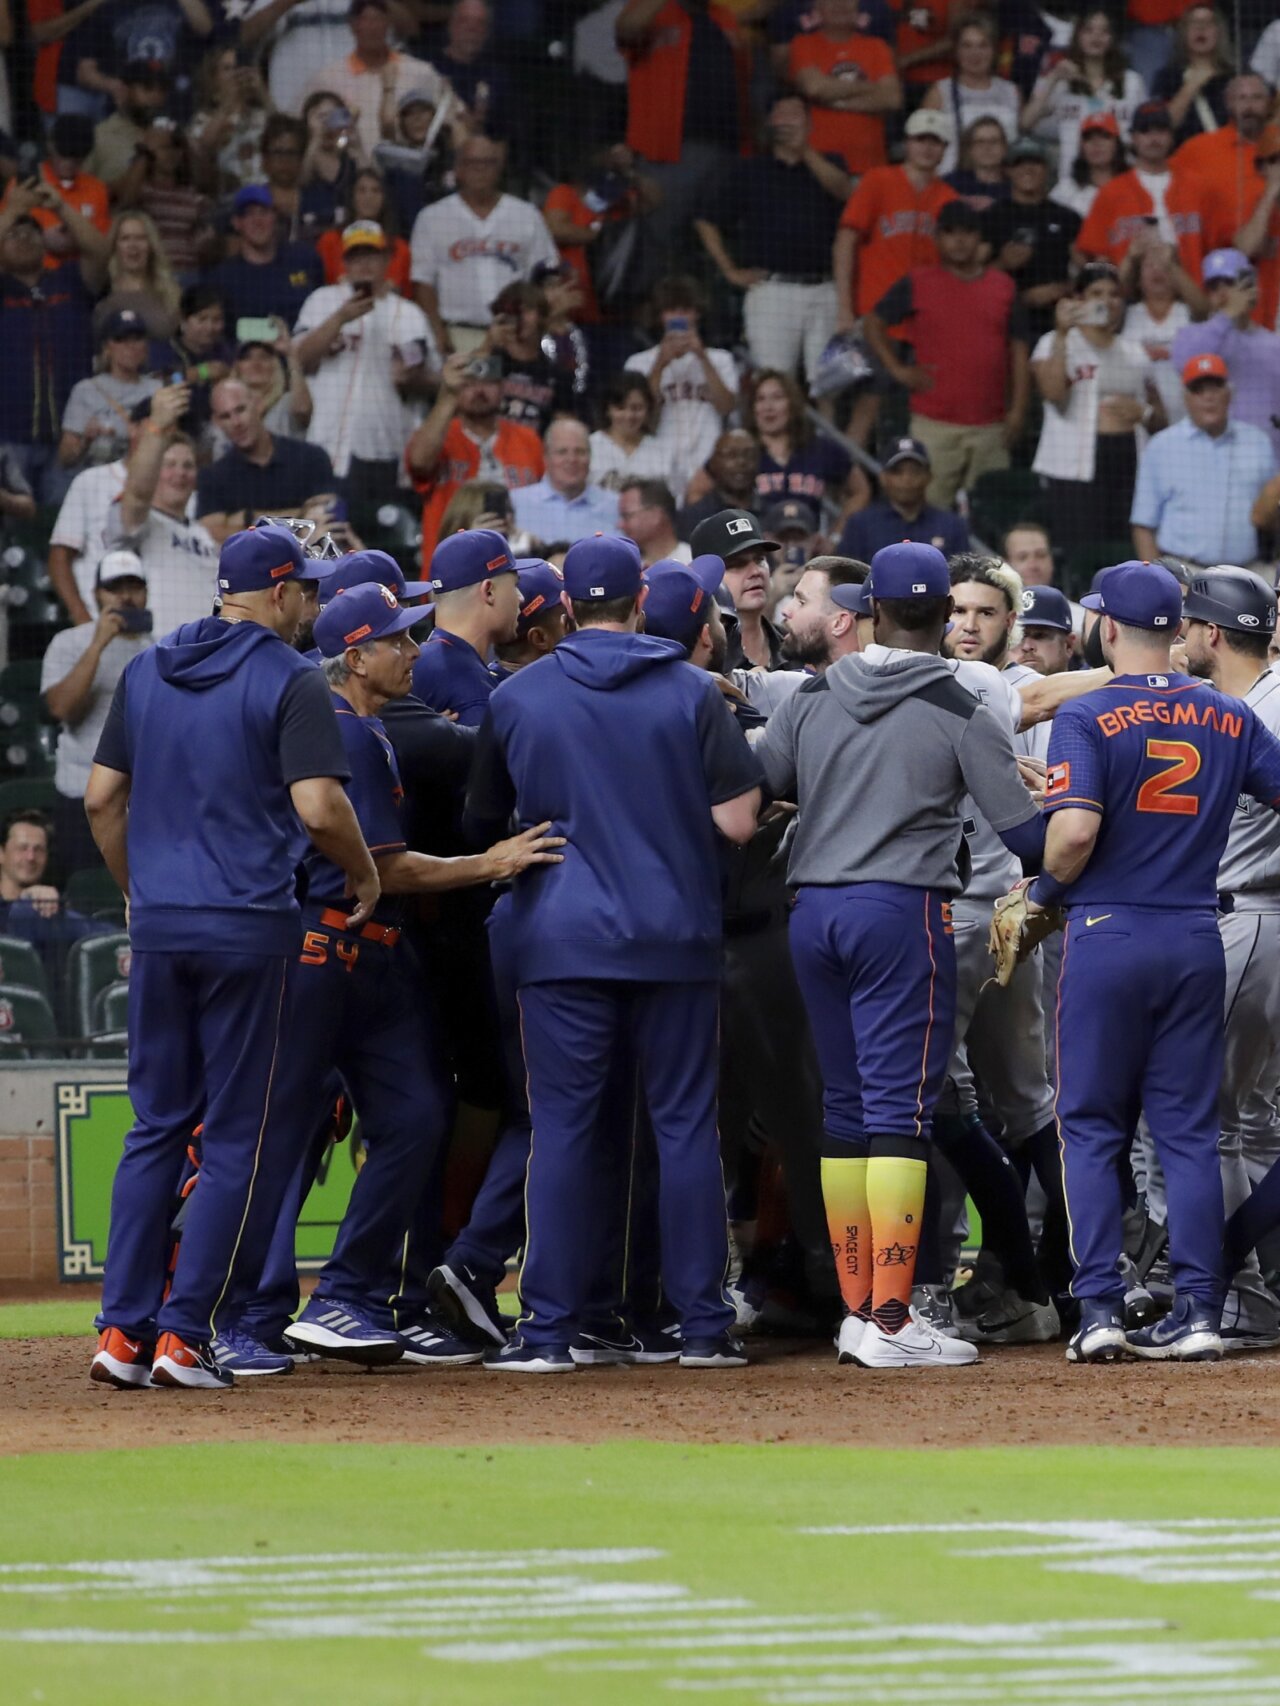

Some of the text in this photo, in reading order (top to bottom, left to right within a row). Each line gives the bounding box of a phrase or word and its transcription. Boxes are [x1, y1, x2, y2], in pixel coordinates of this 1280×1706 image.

[1096, 699, 1244, 738] BREGMAN
[1136, 738, 1201, 815] 2
[299, 930, 359, 972] 54
[846, 1225, 859, 1276] SPACE CITY
